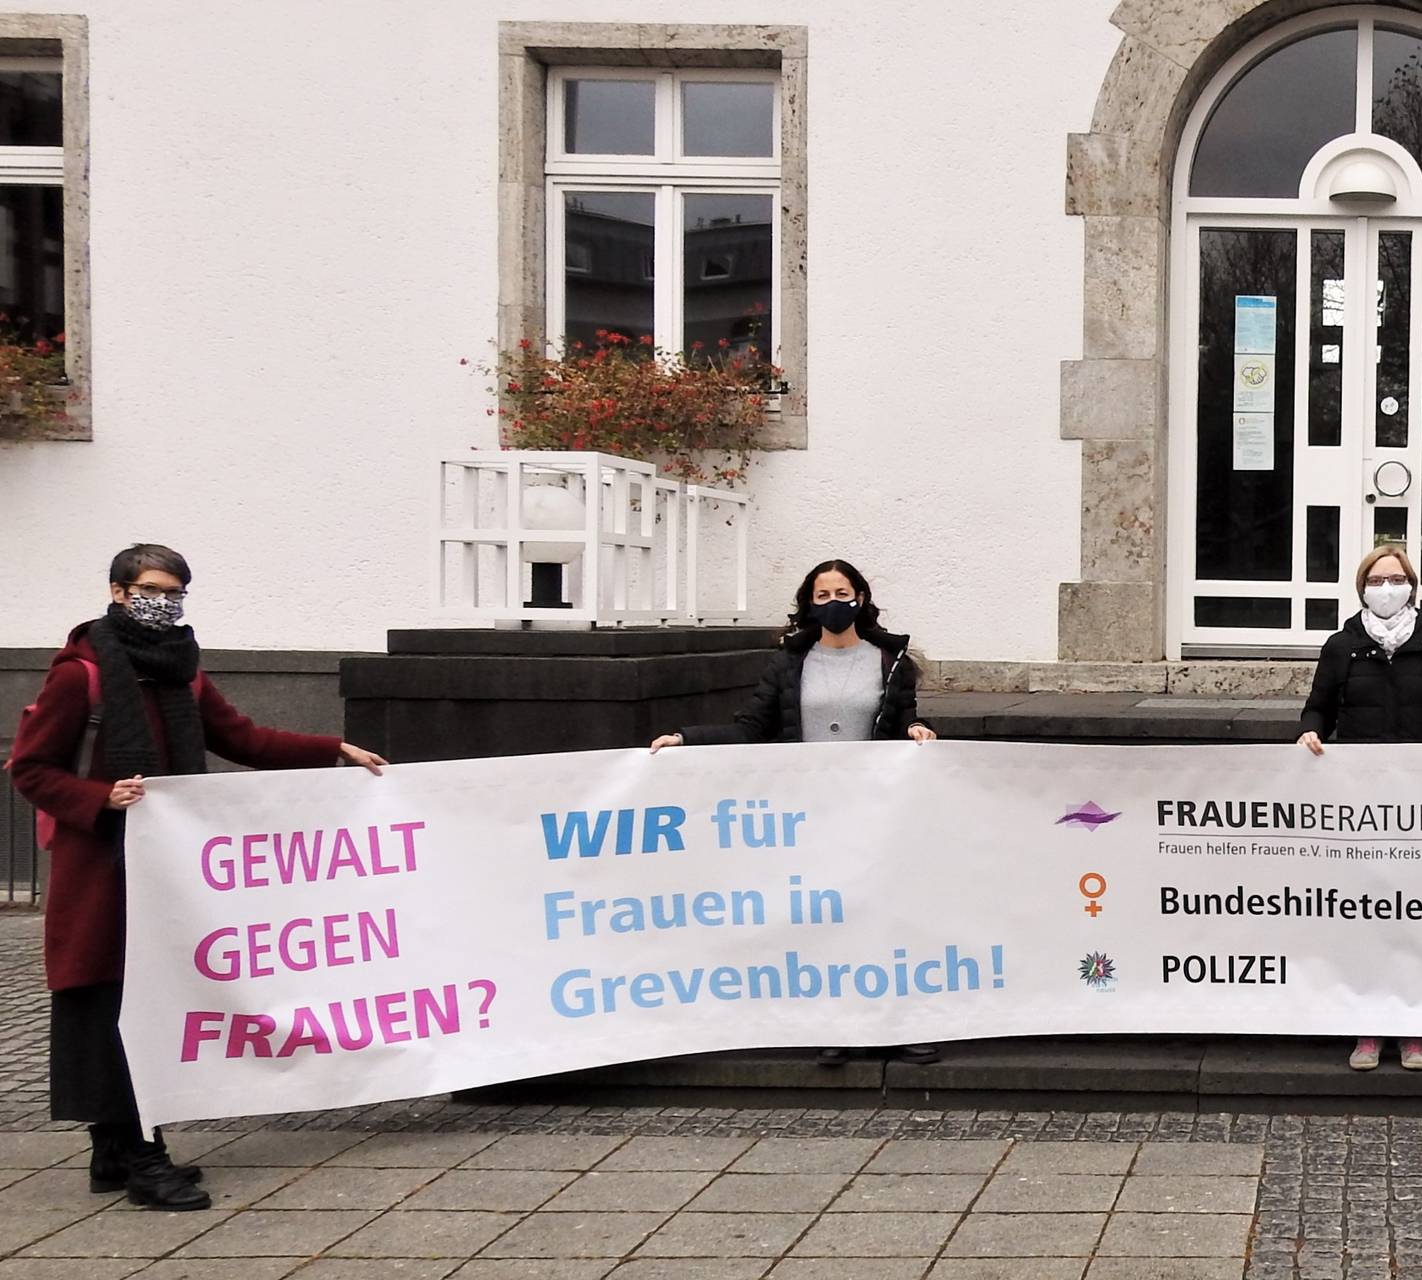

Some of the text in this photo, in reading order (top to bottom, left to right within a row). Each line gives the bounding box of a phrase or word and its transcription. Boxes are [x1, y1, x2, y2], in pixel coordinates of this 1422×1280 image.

[201, 822, 425, 891] GEWALT
[541, 799, 805, 860] WIR für
[1159, 842, 1201, 854] Frauen
[1207, 842, 1246, 855] helfen
[1252, 843, 1294, 855] Frauen
[1300, 845, 1321, 856] e.V.
[1326, 846, 1341, 858] im
[1347, 847, 1420, 859] Rhein-Kreis
[544, 875, 844, 940] Frauen in
[194, 909, 399, 981] GEGEN
[1163, 955, 1286, 984] POLIZEI
[551, 945, 1004, 1017] Grevenbroich!
[181, 979, 496, 1062] FRAUEN?
